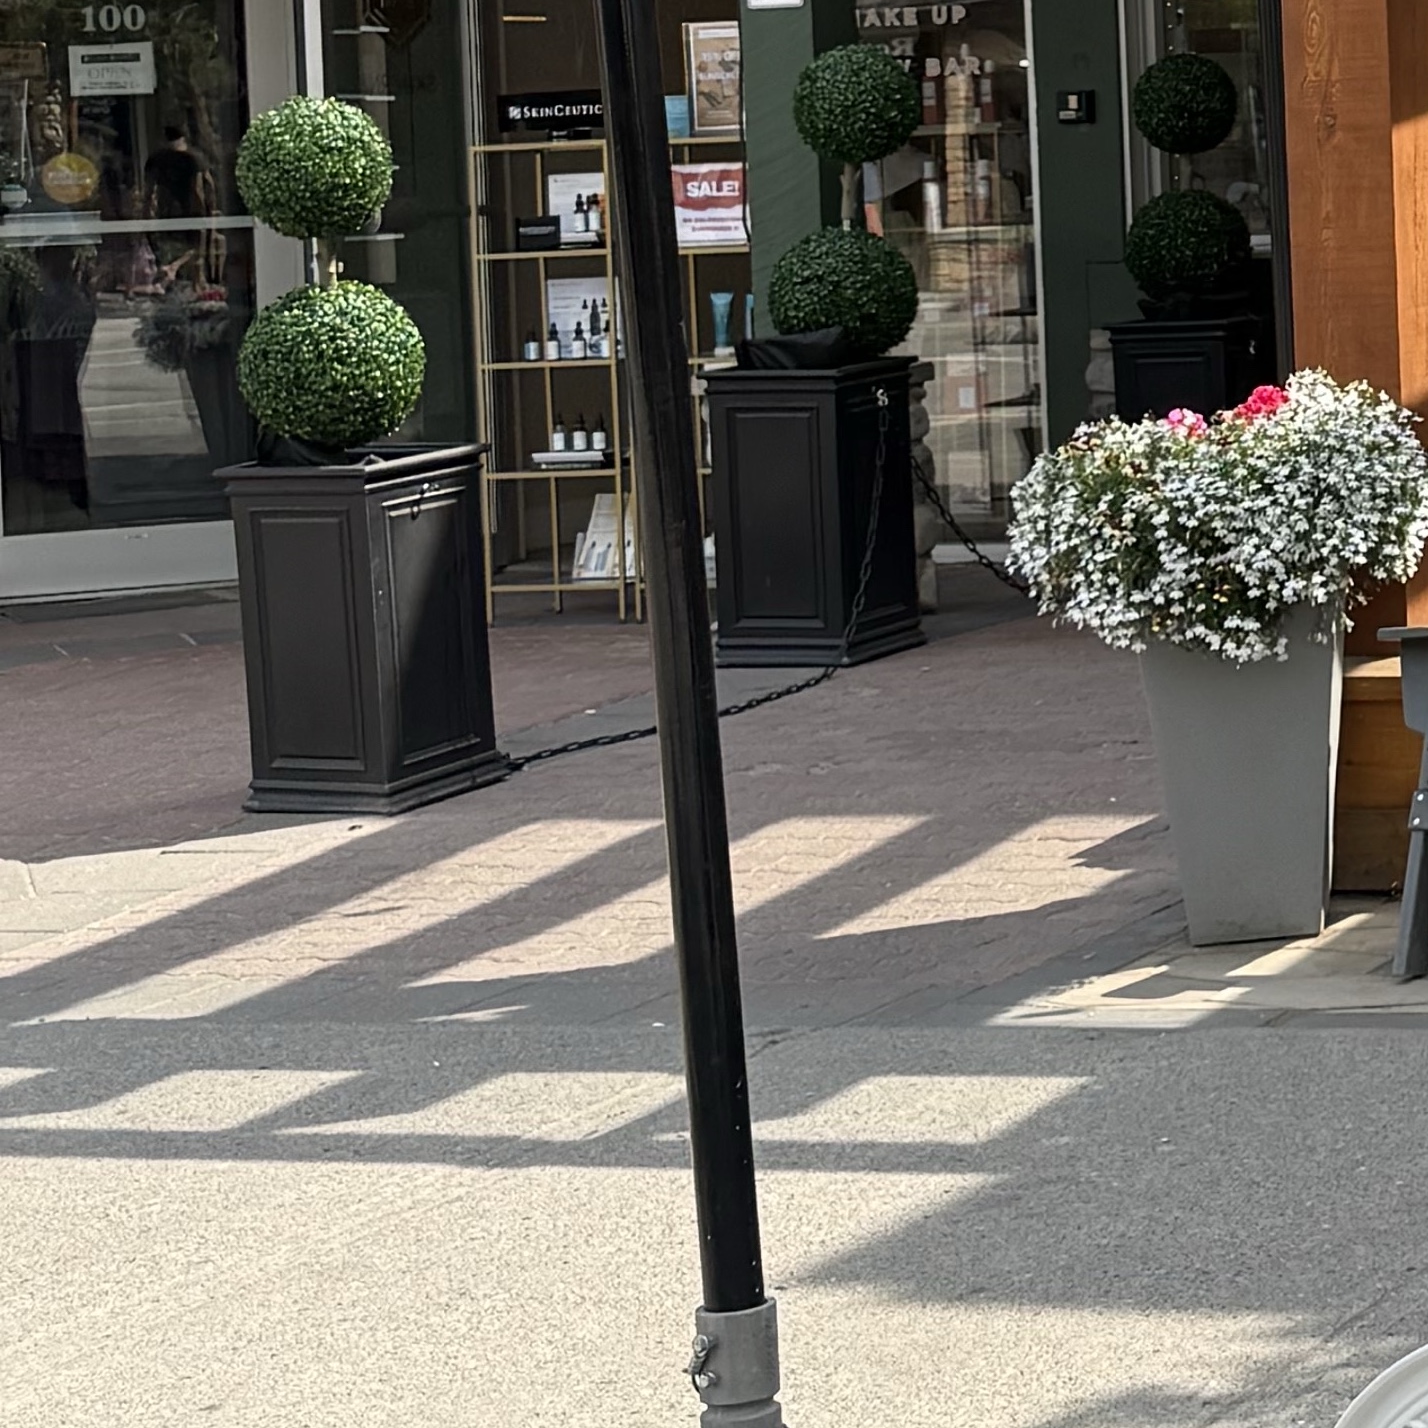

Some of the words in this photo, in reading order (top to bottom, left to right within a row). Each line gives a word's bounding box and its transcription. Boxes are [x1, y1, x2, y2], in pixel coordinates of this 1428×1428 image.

[81, 3, 146, 33] 100
[930, 4, 967, 26] UP
[685, 180, 740, 198] SALE!
